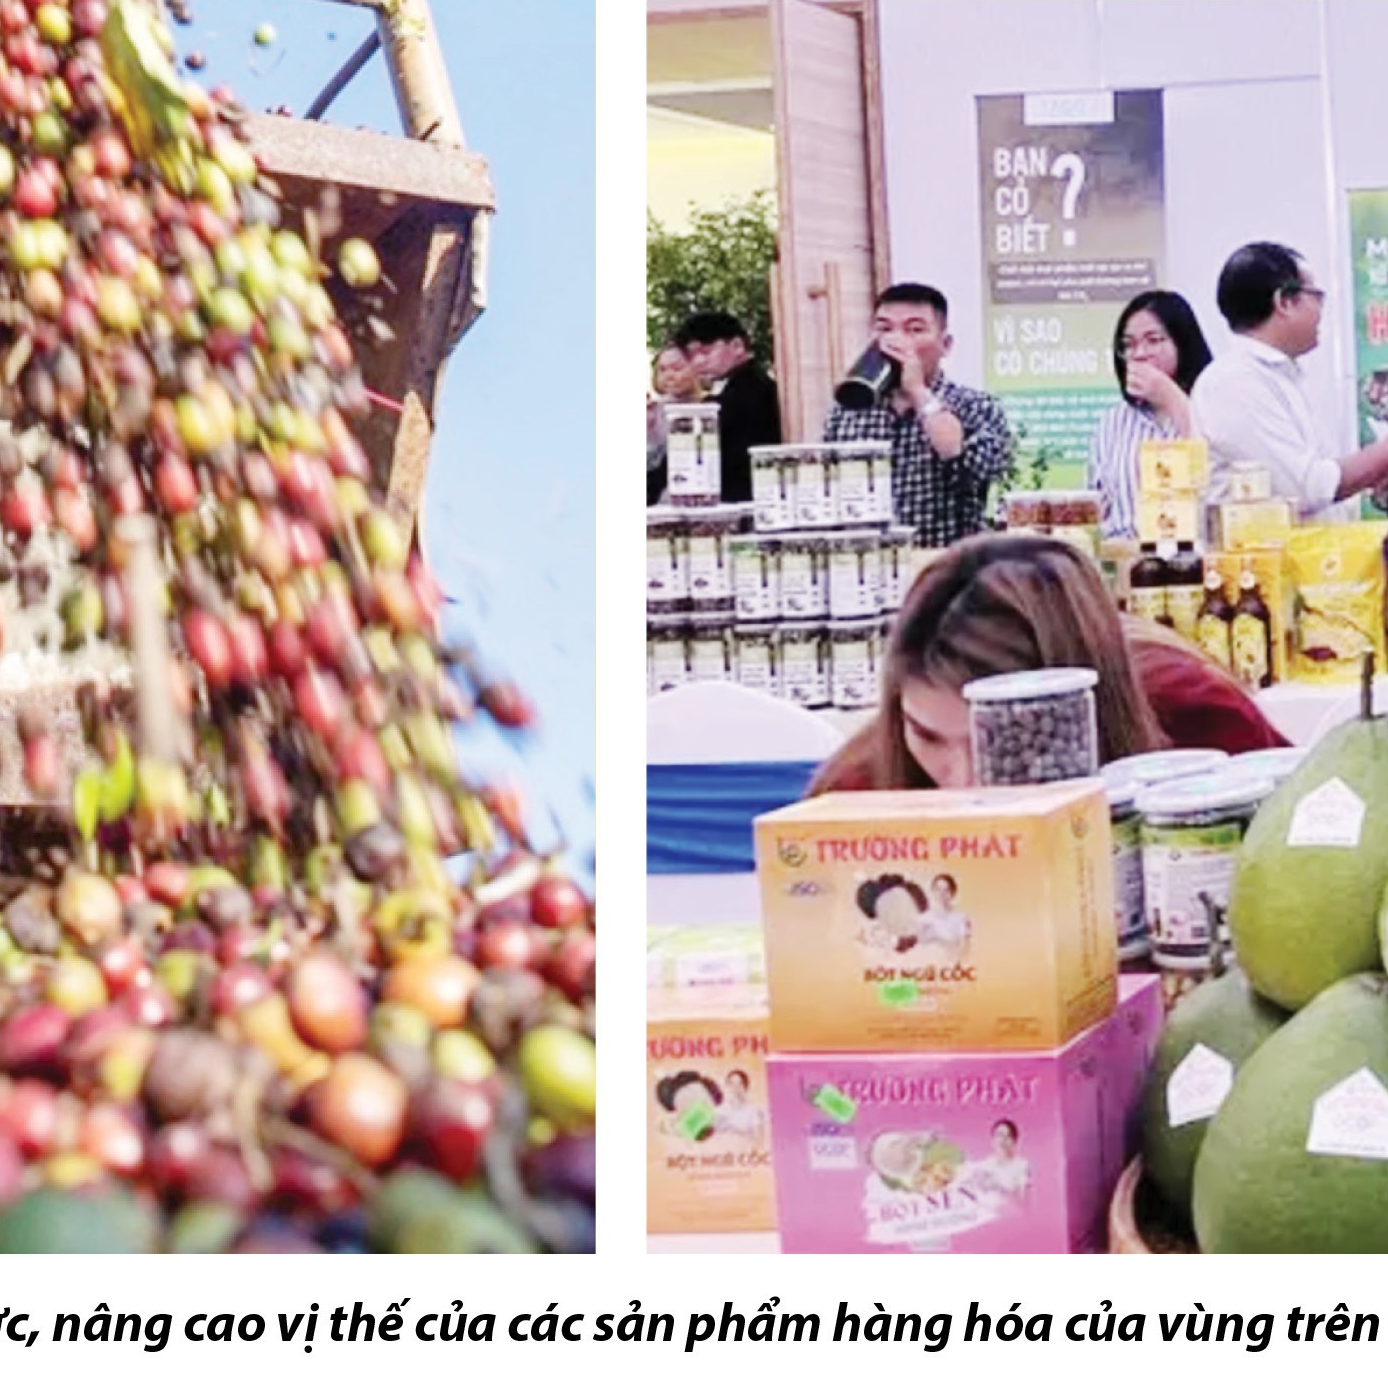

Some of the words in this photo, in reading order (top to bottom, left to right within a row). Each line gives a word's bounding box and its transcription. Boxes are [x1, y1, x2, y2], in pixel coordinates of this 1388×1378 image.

[993, 145, 1048, 180] BẠN
[995, 215, 1050, 253] BIẾT
[1049, 151, 1086, 247] ?
[1020, 316, 1061, 343] SAO
[732, 1034, 769, 1057] PH
